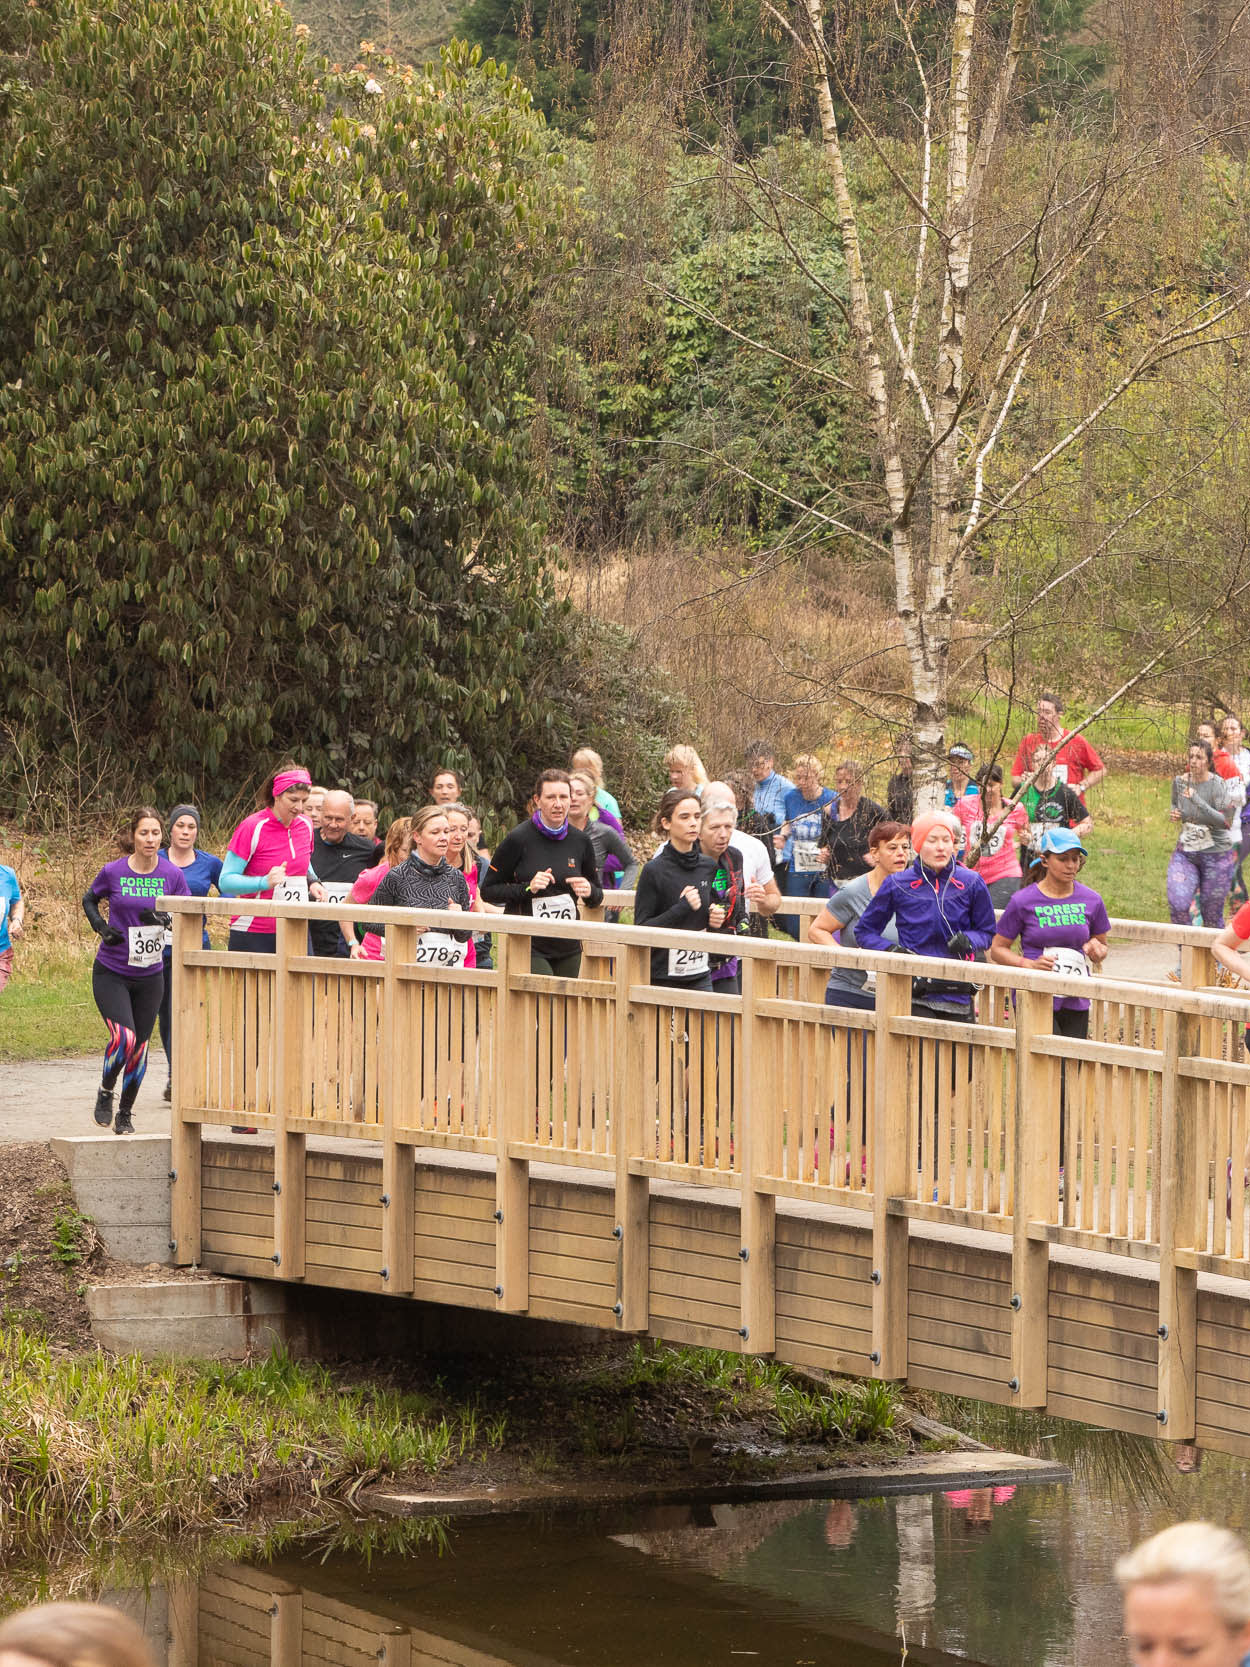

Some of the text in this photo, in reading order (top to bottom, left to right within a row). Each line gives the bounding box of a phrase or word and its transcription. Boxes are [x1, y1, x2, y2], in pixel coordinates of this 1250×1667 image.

[119, 876, 166, 888] FOREST
[121, 887, 165, 898] FLIERS
[1034, 903, 1087, 919] FOREST
[1038, 914, 1086, 929] FLIERS
[135, 938, 162, 955] 366
[416, 947, 449, 963] 278
